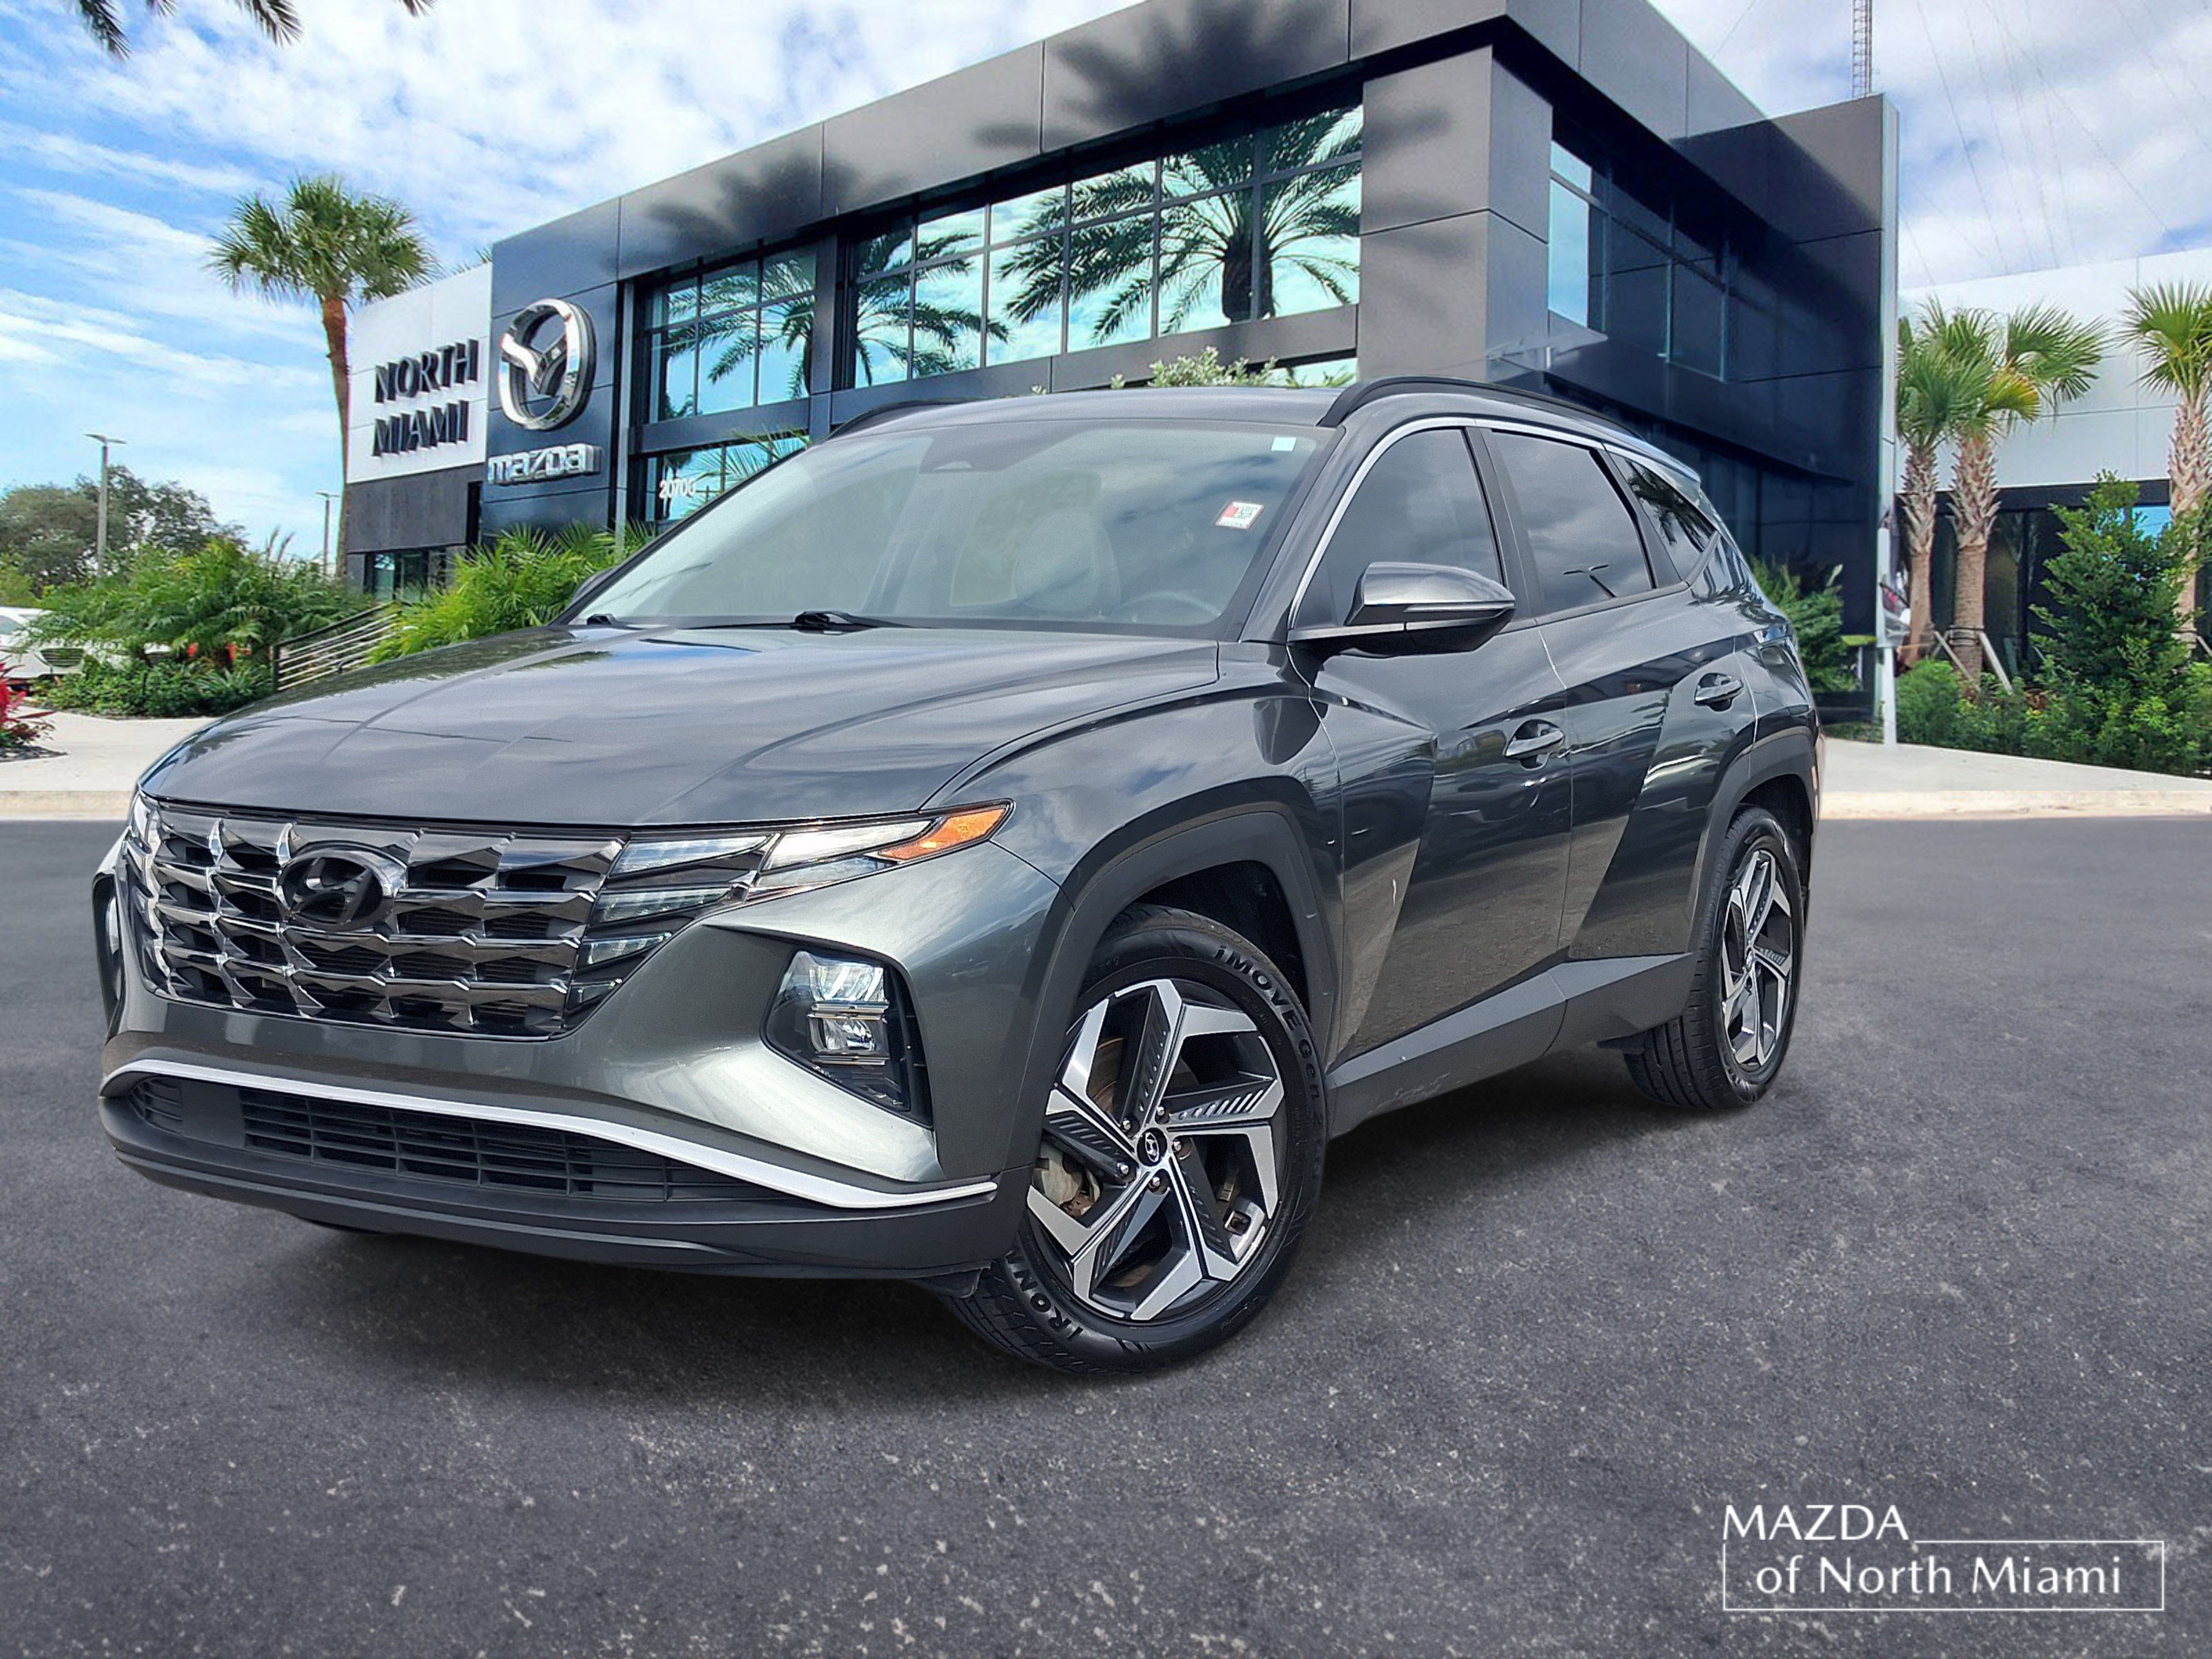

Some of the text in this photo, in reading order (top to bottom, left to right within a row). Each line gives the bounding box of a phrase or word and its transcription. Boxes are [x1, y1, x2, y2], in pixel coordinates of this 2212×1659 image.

[375, 338, 478, 404] NORTH
[372, 400, 469, 457] MIAMI
[1213, 945, 1302, 1031] iMOVE
[1298, 1038, 1320, 1100] Gen
